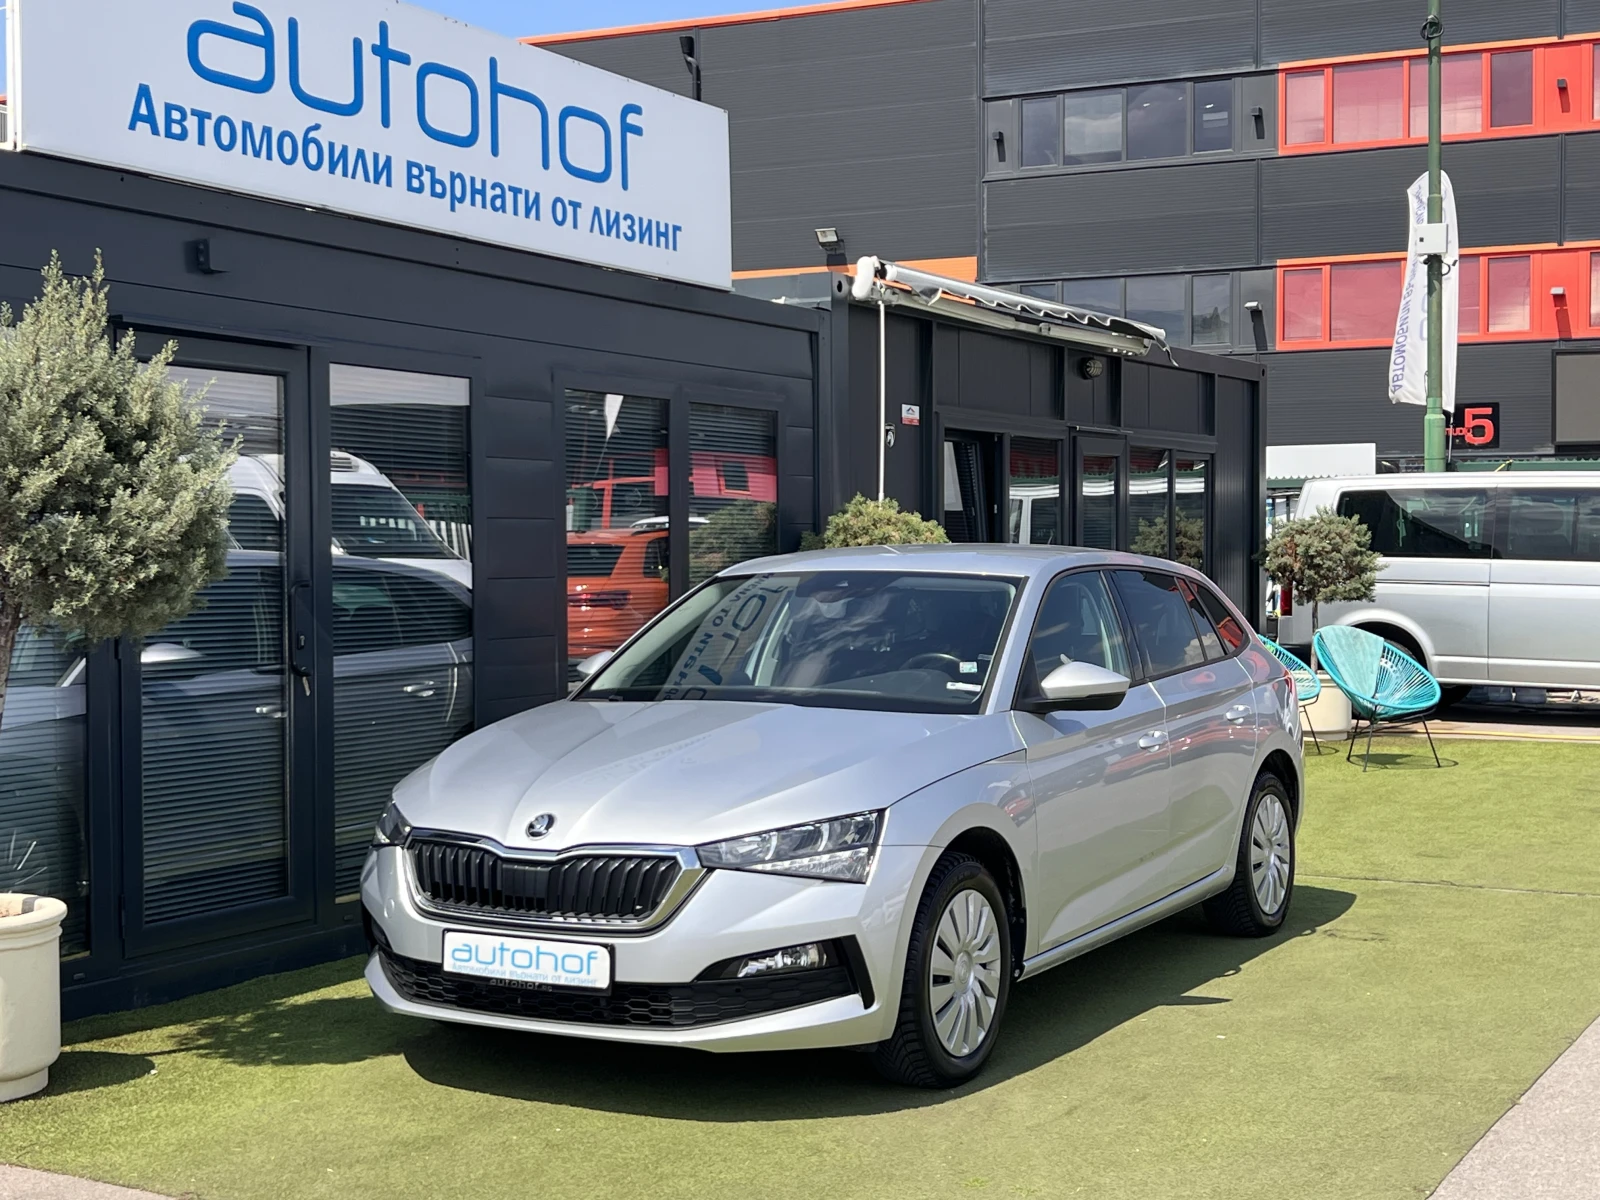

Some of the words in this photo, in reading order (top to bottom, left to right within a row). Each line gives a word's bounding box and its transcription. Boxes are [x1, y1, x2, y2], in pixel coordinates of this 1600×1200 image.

[187, 1, 643, 190] autohof
[128, 83, 393, 188] Автомобили
[406, 160, 541, 220] върнати
[551, 196, 582, 229] от
[590, 206, 682, 252] лизинг
[1464, 407, 1494, 444] 5
[451, 941, 598, 976] autohof
